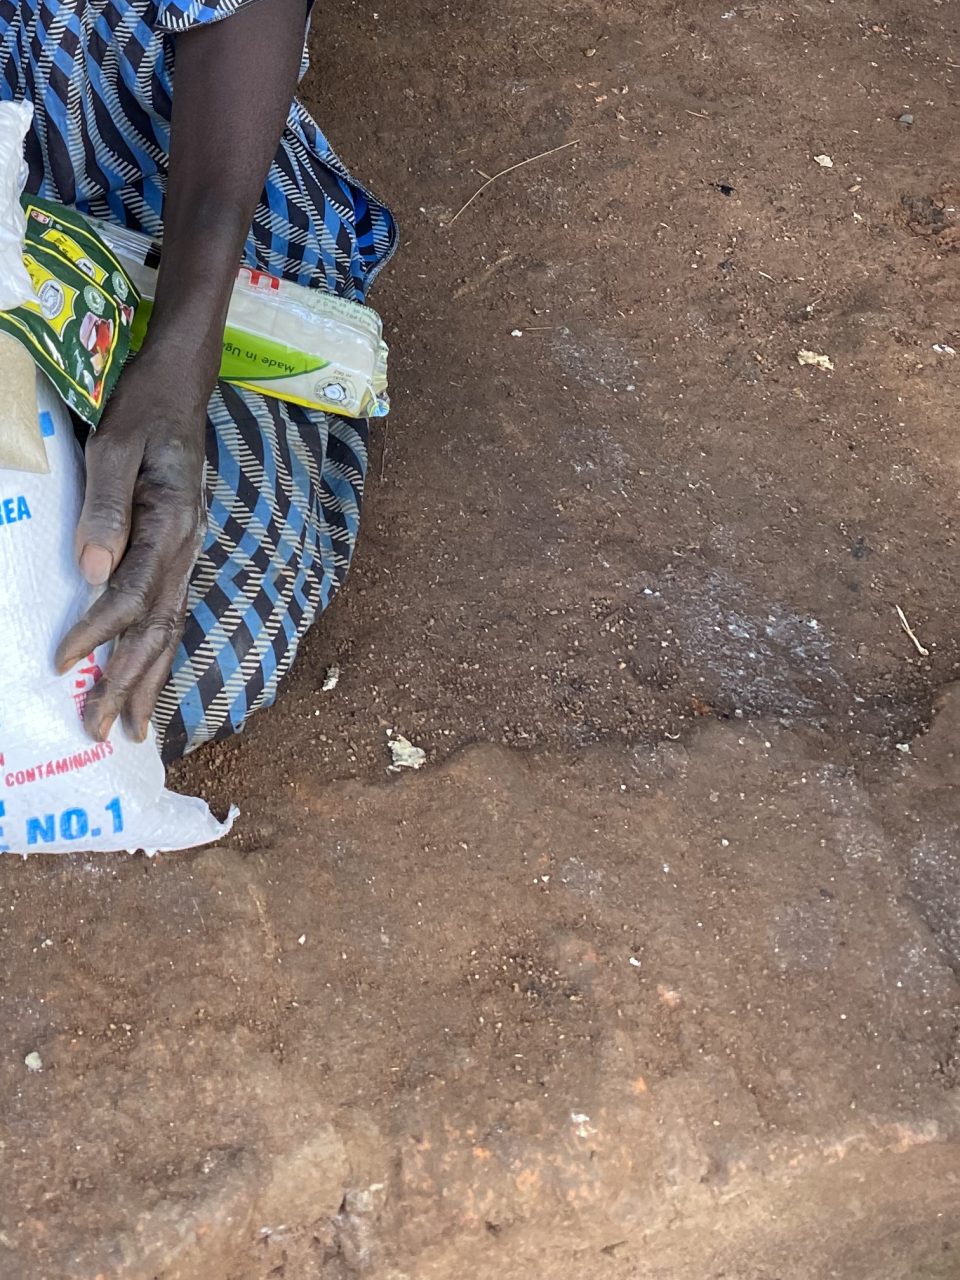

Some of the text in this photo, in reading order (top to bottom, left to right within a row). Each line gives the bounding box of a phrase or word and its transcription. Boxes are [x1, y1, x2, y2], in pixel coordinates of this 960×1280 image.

[223, 342, 295, 373] Made in Ug
[5, 740, 114, 788] CONTAMINANTS
[26, 796, 124, 845] NO.1
